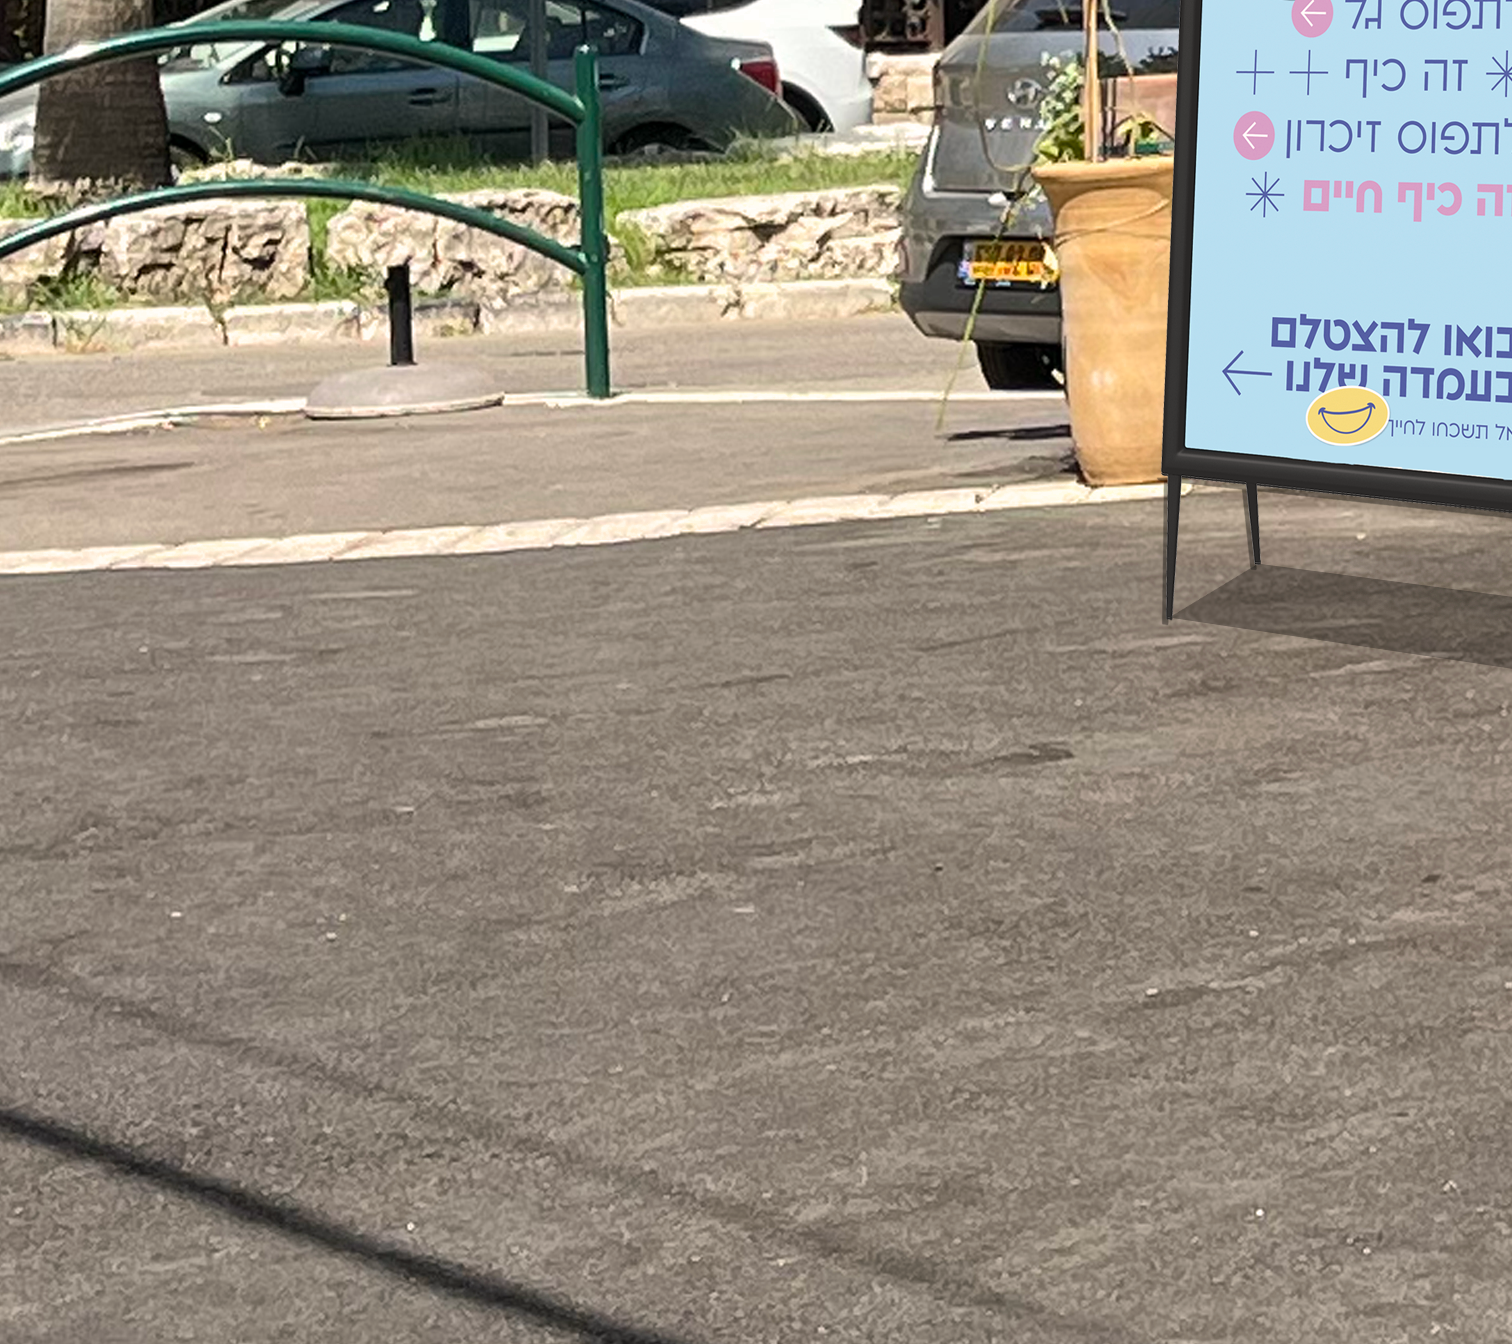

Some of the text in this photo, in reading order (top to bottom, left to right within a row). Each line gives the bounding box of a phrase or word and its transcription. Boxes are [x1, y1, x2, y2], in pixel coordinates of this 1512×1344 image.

[1345, 58, 1468, 98] זה כיף
[1286, 119, 1382, 159] זיכרון
[1302, 179, 1383, 214] חיים
[1397, 181, 1463, 223] כיף
[1270, 313, 1431, 355] להצטלם
[1285, 357, 1368, 393] שלנו
[1388, 418, 1426, 437] לחייך
[1431, 421, 1489, 440] תשכחו
